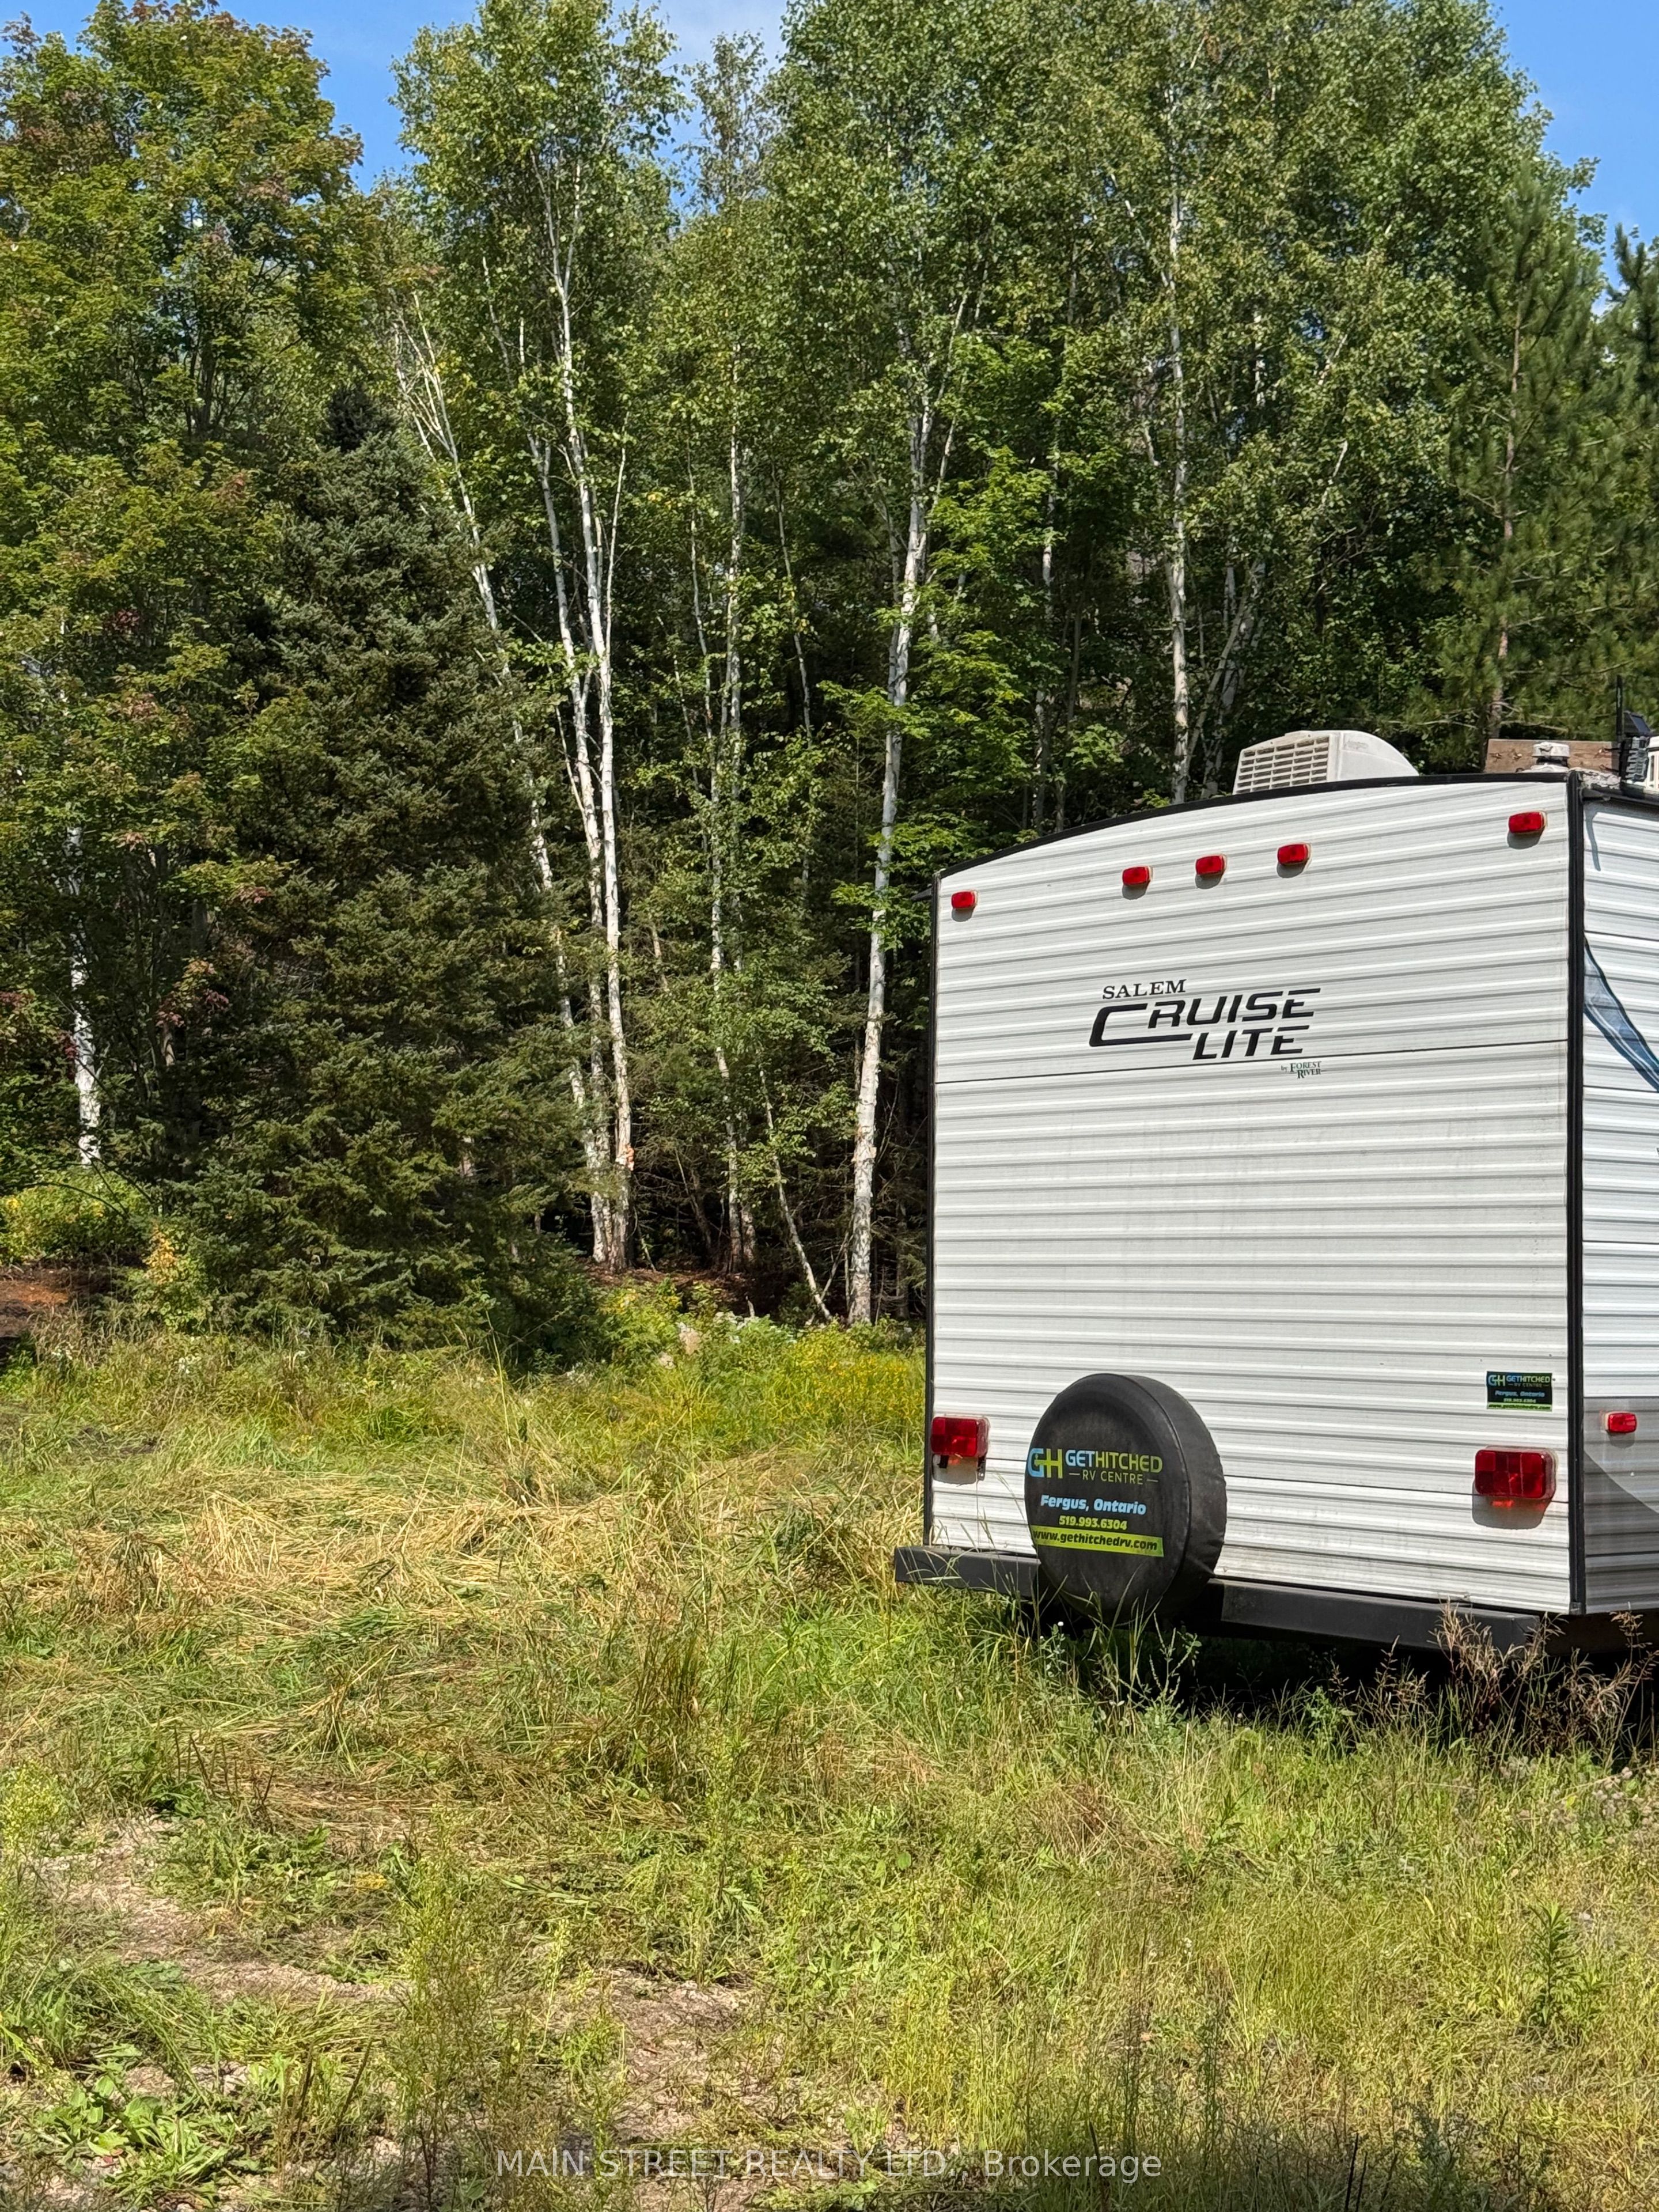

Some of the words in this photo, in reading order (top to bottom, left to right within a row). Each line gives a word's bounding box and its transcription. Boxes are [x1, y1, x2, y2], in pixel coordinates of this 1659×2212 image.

[1103, 979, 1187, 999] SALEM
[1089, 988, 1321, 1047] CRUISE
[1192, 1025, 1309, 1060] LITE
[1290, 1061, 1322, 1072] FOREST
[1297, 1069, 1321, 1079] RIVER
[1506, 1375, 1550, 1383] GETHITCHED
[1066, 1449, 1162, 1473] GETHITCHED
[1082, 1469, 1096, 1481] RV
[1100, 1471, 1143, 1484] CENTRE
[1040, 1495, 1089, 1512] Fergus,
[1094, 1498, 1146, 1515] Ontario
[1059, 1515, 1127, 1531] 519.993.6304
[1033, 1531, 1157, 1551] www.gethitchedrv.com
